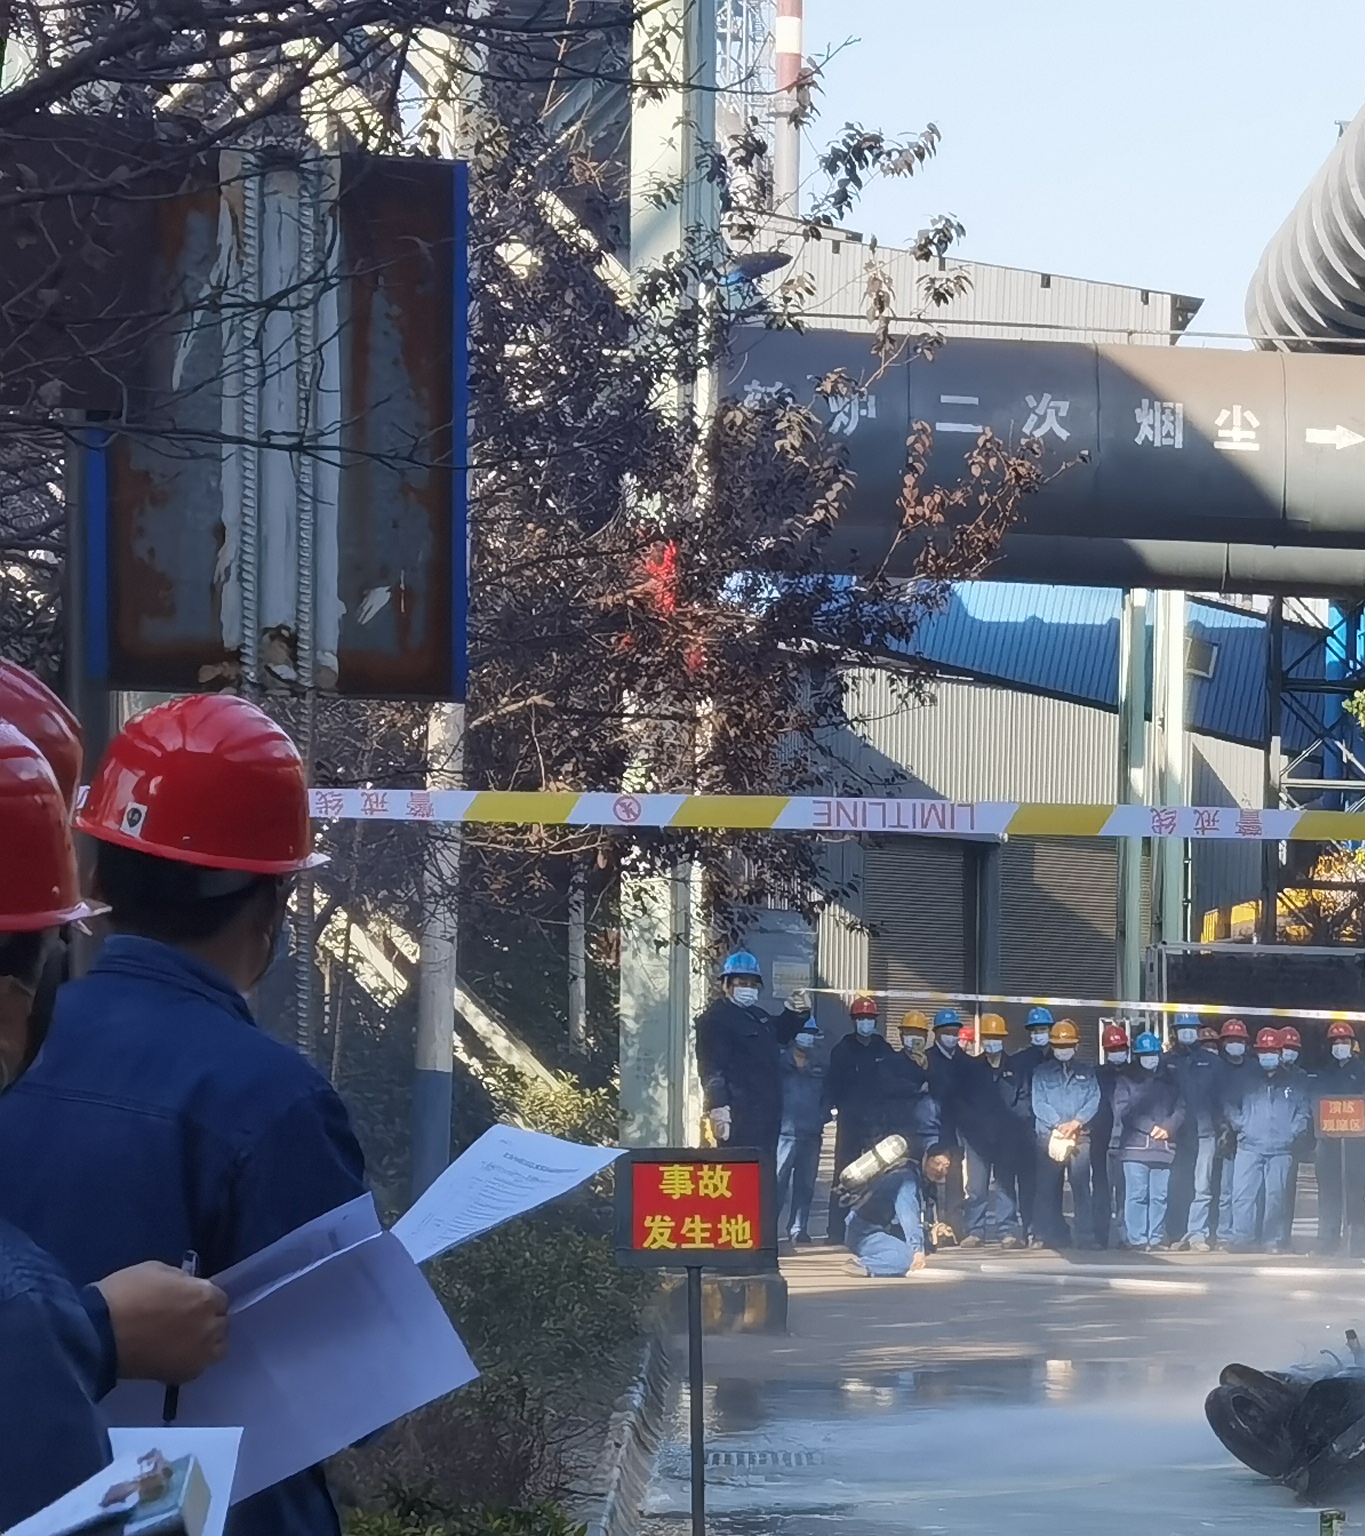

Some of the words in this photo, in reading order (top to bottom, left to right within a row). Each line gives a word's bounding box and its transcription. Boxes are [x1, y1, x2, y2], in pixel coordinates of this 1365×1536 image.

[812, 800, 976, 832] LIMITLINE
[1149, 807, 1263, 837] 警戒线
[658, 1163, 733, 1200] 事故
[642, 1213, 754, 1250] 发生地
